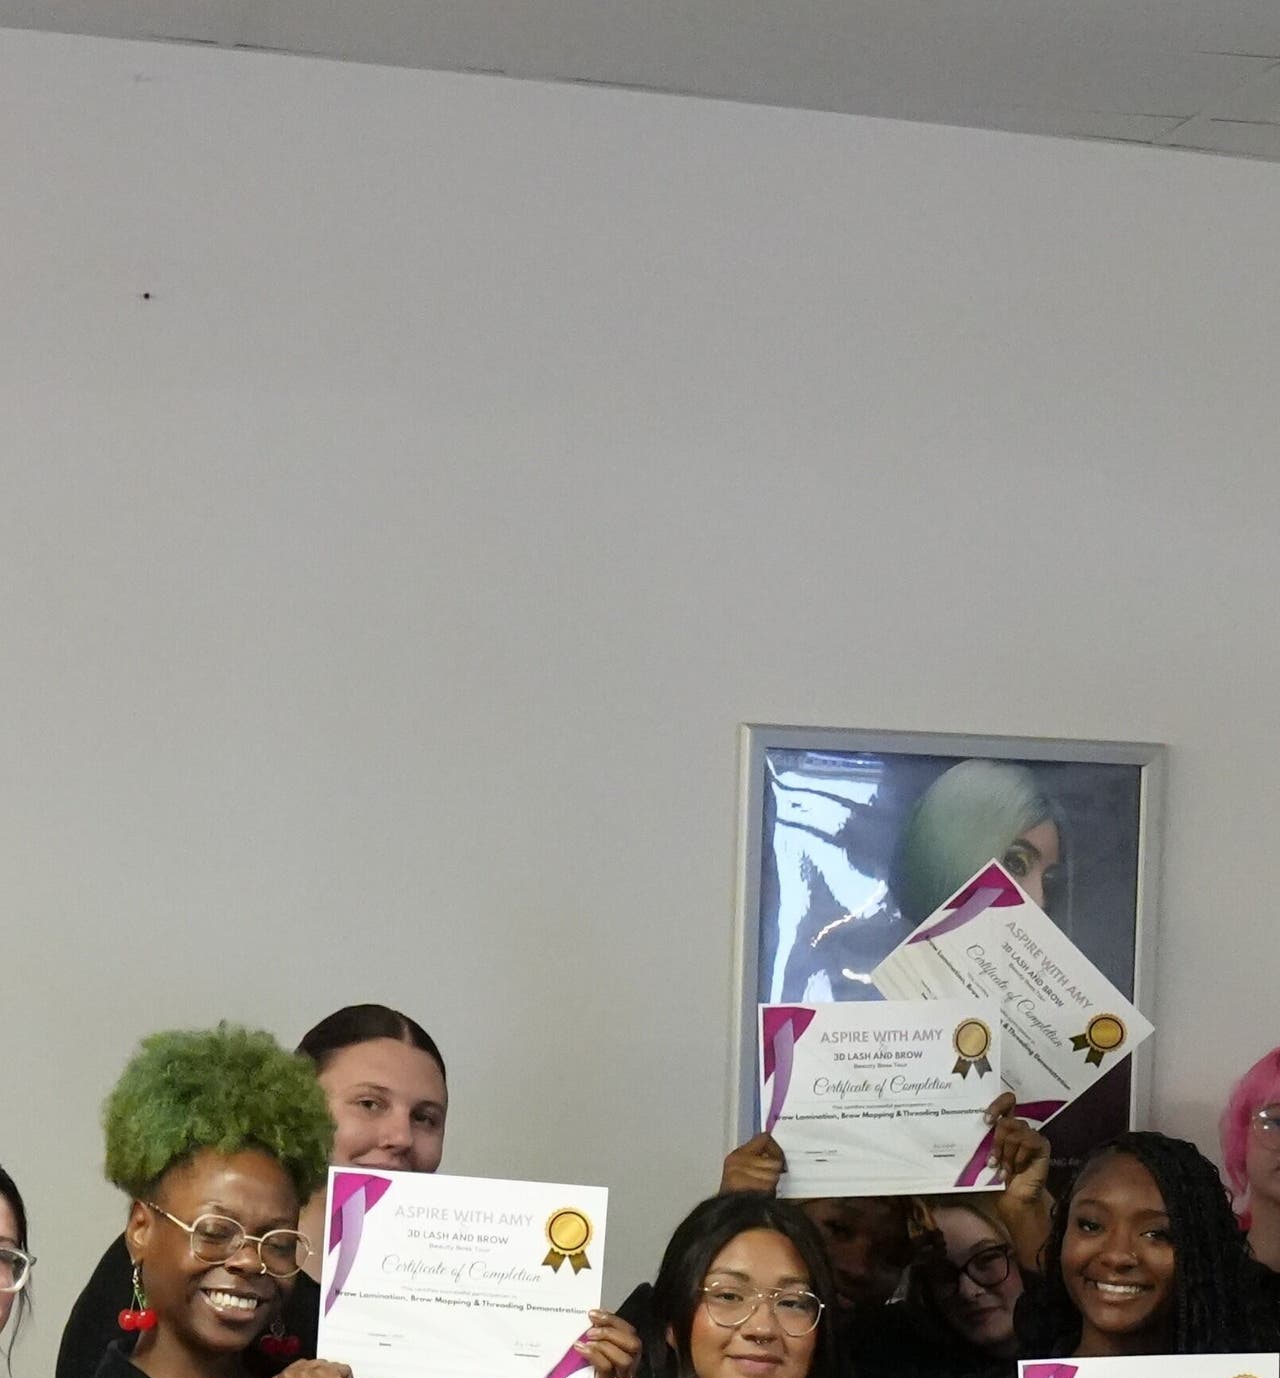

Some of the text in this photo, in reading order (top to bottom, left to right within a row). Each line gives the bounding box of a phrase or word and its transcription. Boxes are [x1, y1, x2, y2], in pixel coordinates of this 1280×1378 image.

[1000, 942, 1066, 1007] 3D LASH AND BROW
[1004, 921, 1094, 1009] ASPIRE WITH AMY
[820, 1028, 943, 1043] ASPIRE WITH AMY
[833, 1050, 923, 1061] 3D LASH AND BROW
[812, 1074, 952, 1100] Certificate of Completion
[393, 1205, 535, 1228] ASPIRE WITH AMY
[406, 1228, 509, 1245] 3D LASH AND BROW
[381, 1253, 541, 1286] Certificate of Completion
